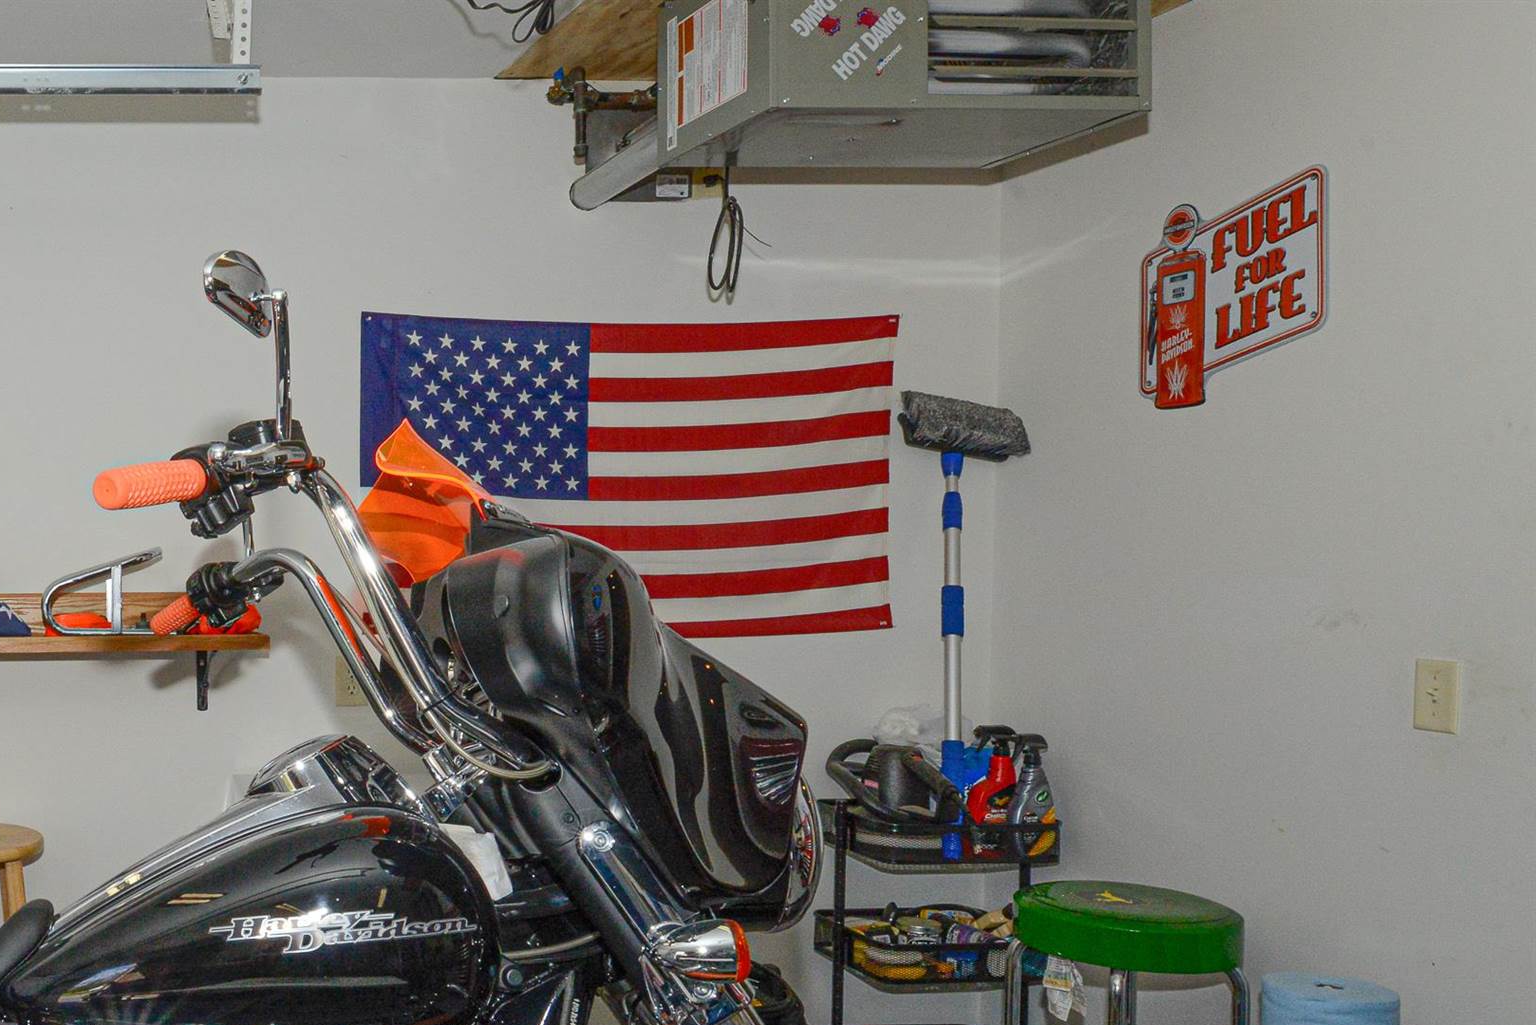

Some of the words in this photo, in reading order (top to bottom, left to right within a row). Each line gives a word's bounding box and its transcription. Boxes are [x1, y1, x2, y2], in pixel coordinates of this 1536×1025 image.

[832, 42, 868, 81] HOT
[860, 6, 906, 52] DAWG
[1211, 184, 1318, 274] FUEL
[1215, 268, 1306, 350] LIFE
[1234, 247, 1287, 294] FOR
